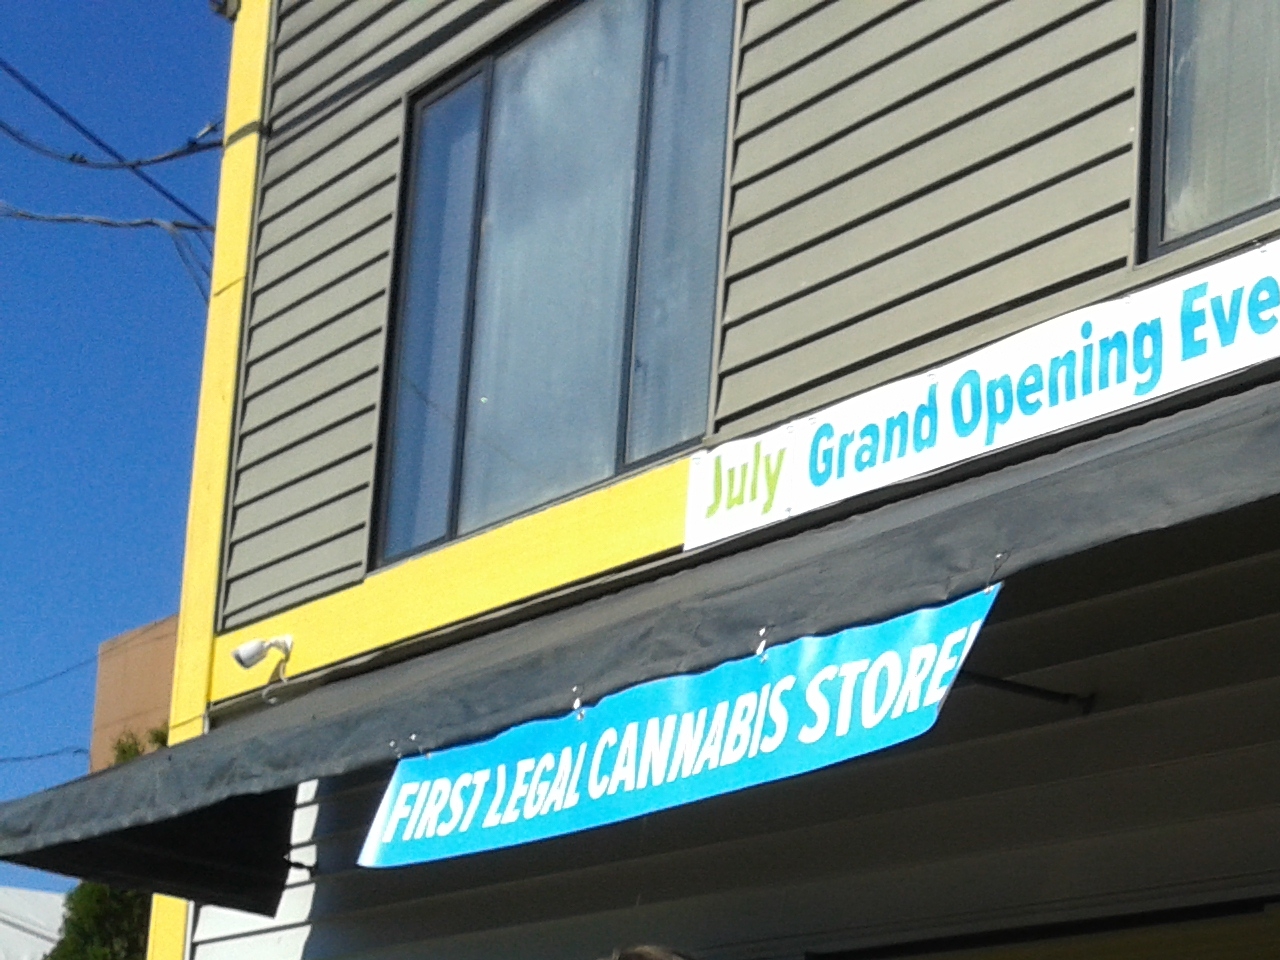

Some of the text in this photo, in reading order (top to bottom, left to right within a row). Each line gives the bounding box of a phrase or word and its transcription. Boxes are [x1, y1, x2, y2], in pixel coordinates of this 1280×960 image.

[705, 441, 785, 519] July
[808, 374, 938, 488] Grand
[951, 320, 1162, 447] Opening
[383, 768, 489, 843] FIRST
[483, 743, 589, 828] LEGAL
[588, 675, 797, 800] CANNABIS
